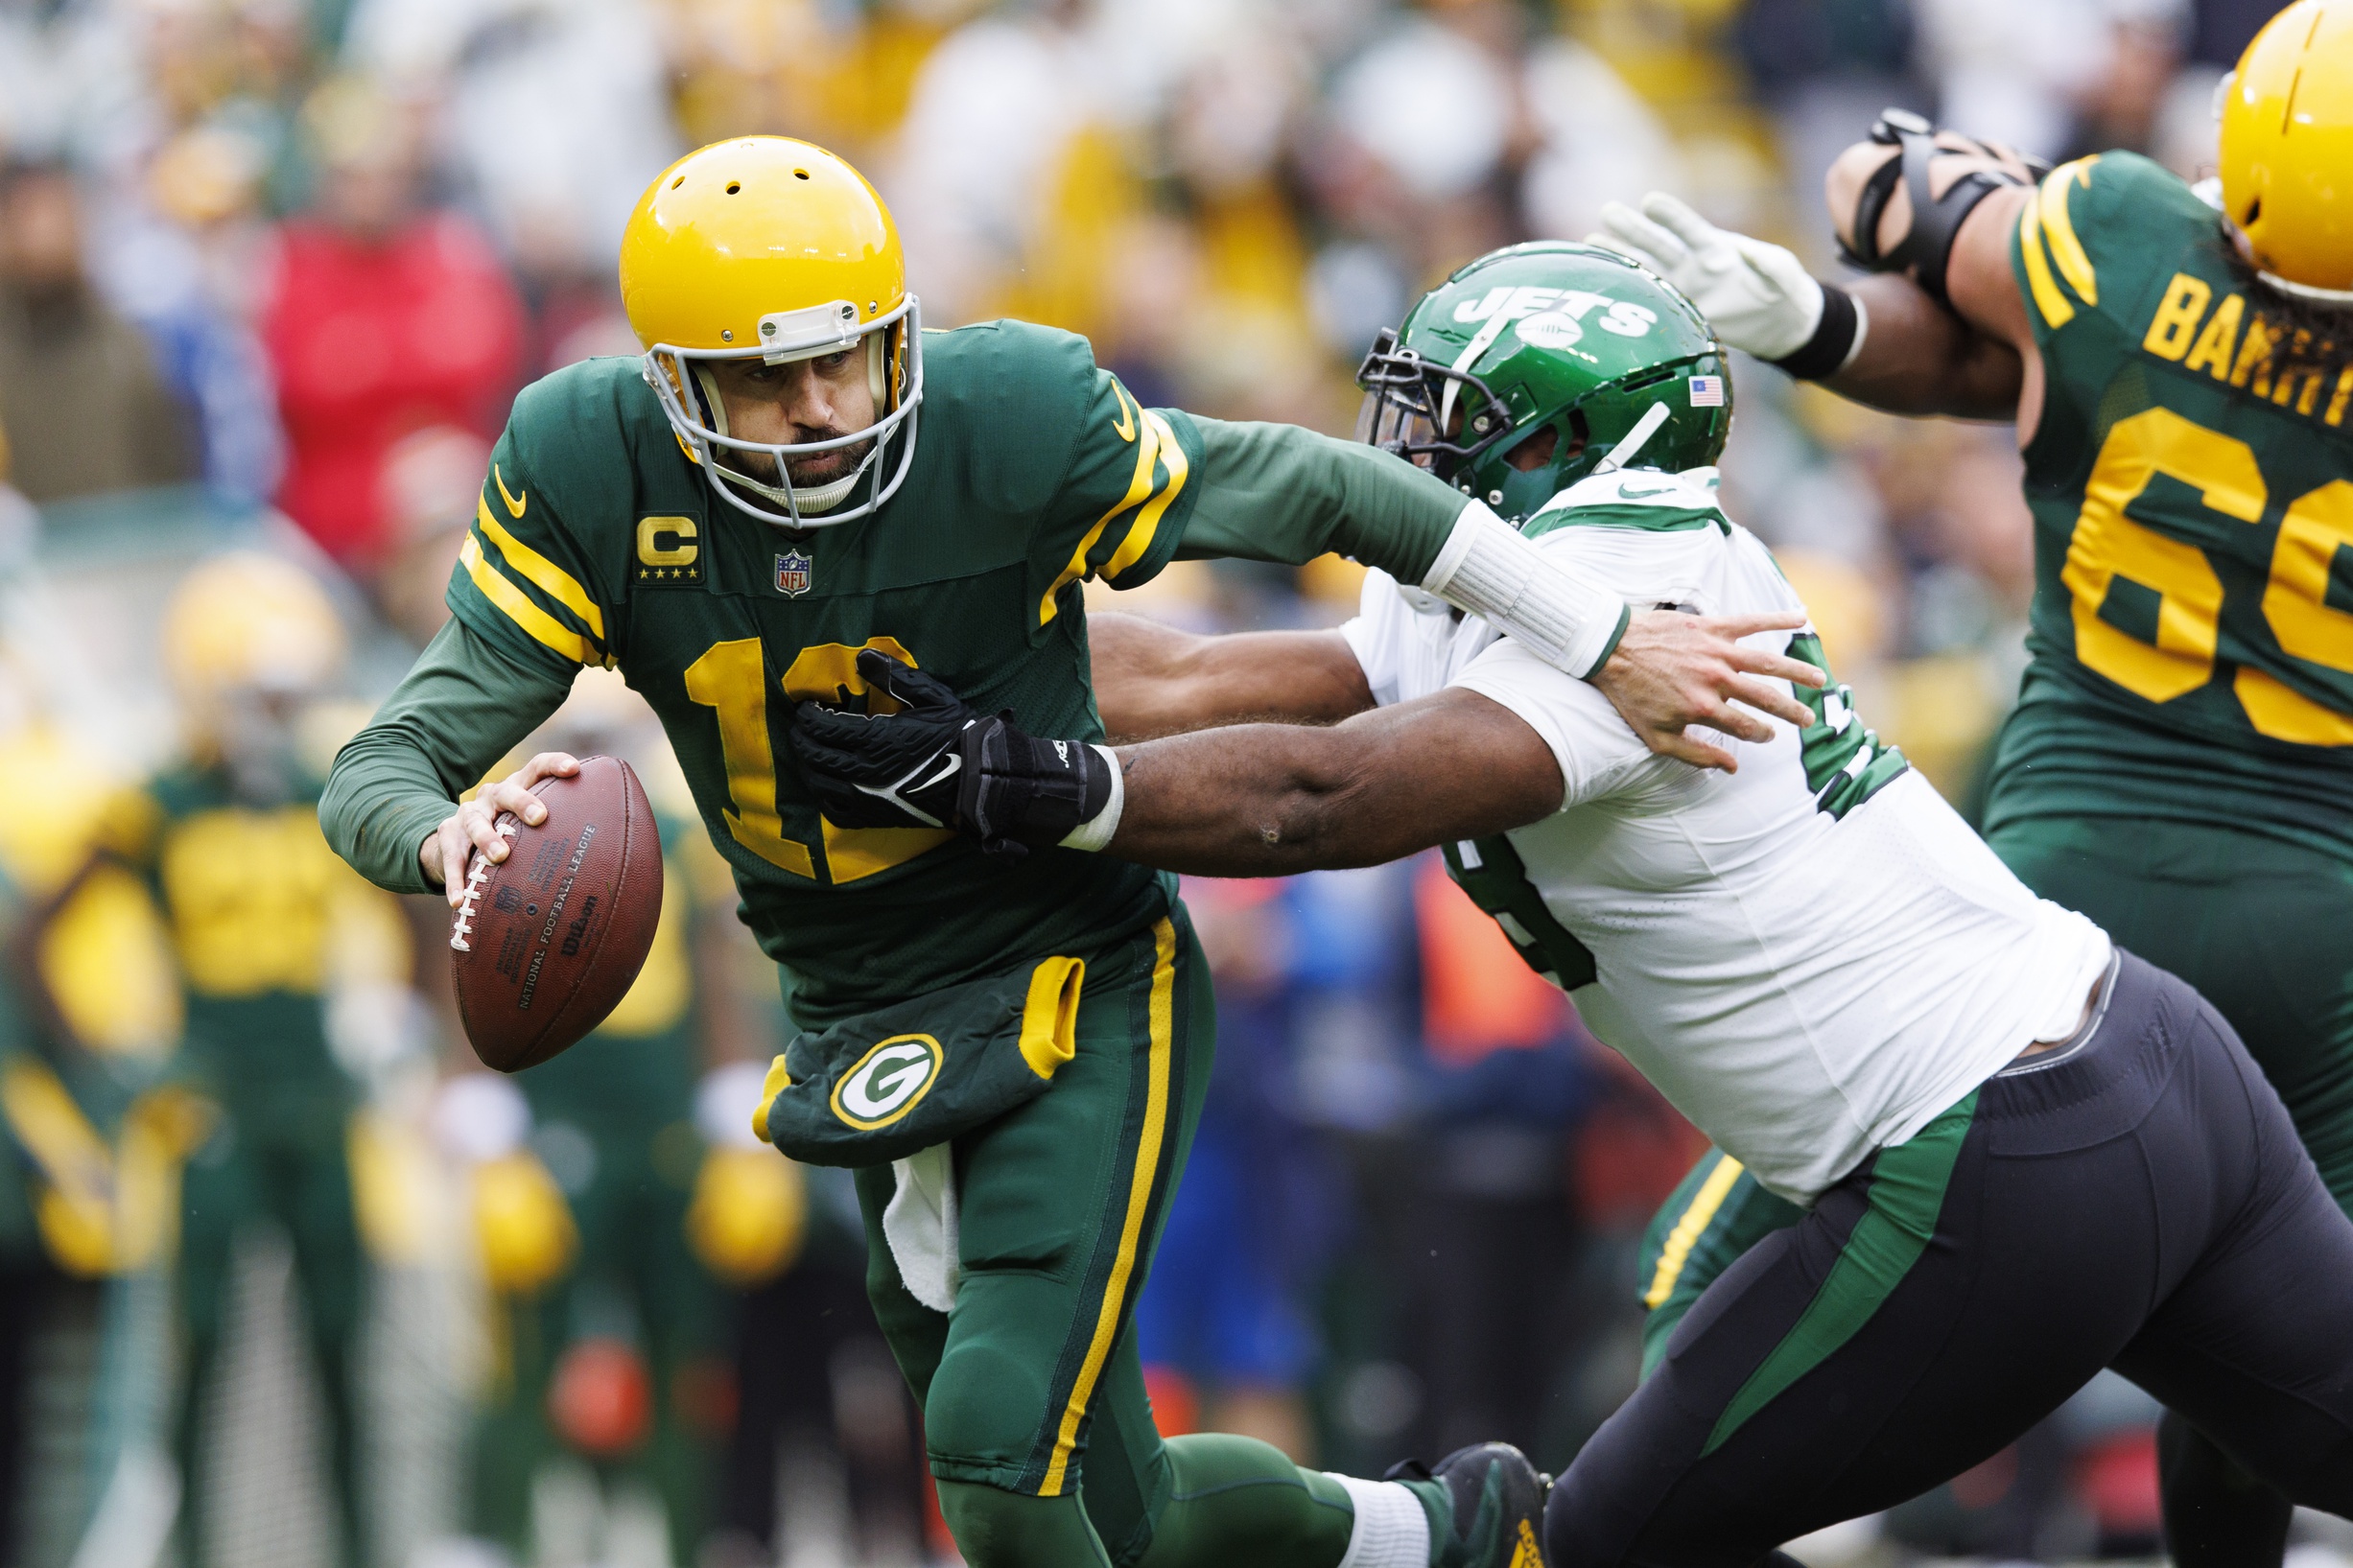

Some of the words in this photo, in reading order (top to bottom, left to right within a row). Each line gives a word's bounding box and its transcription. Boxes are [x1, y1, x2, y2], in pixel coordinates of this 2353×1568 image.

[1452, 286, 1659, 338] JETS
[636, 516, 698, 567] C
[779, 571, 807, 591] NFL
[519, 949, 545, 1009] NATIONAL
[540, 877, 573, 945] FOOTBALL
[569, 825, 596, 873] LEAGUE
[562, 896, 598, 956] Wilson
[842, 1043, 930, 1117] G
